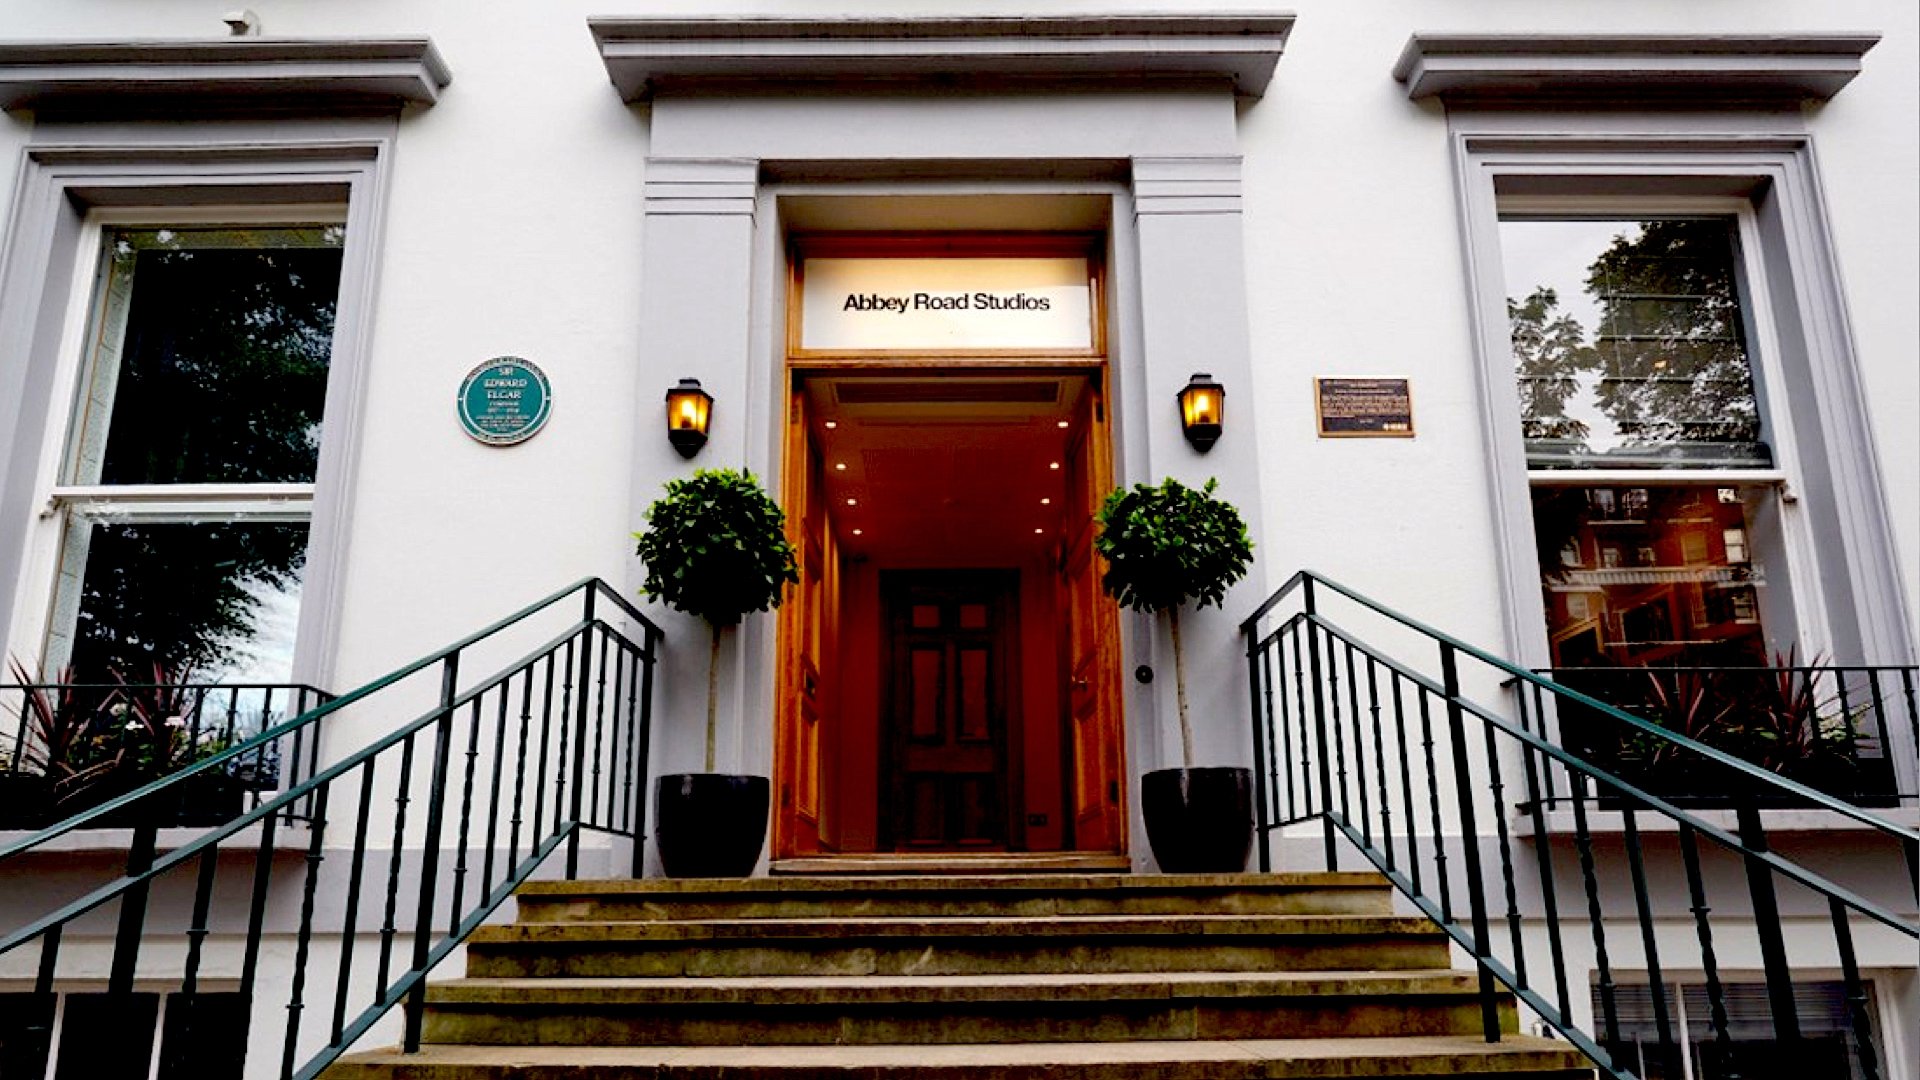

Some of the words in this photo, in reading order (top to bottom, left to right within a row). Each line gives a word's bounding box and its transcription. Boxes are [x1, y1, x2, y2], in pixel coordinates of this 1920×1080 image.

[843, 293, 910, 313] Abbey
[914, 292, 969, 310] Road
[973, 292, 1050, 311] Studios
[484, 379, 527, 387] EDWARD
[487, 390, 521, 399] ELGAR
